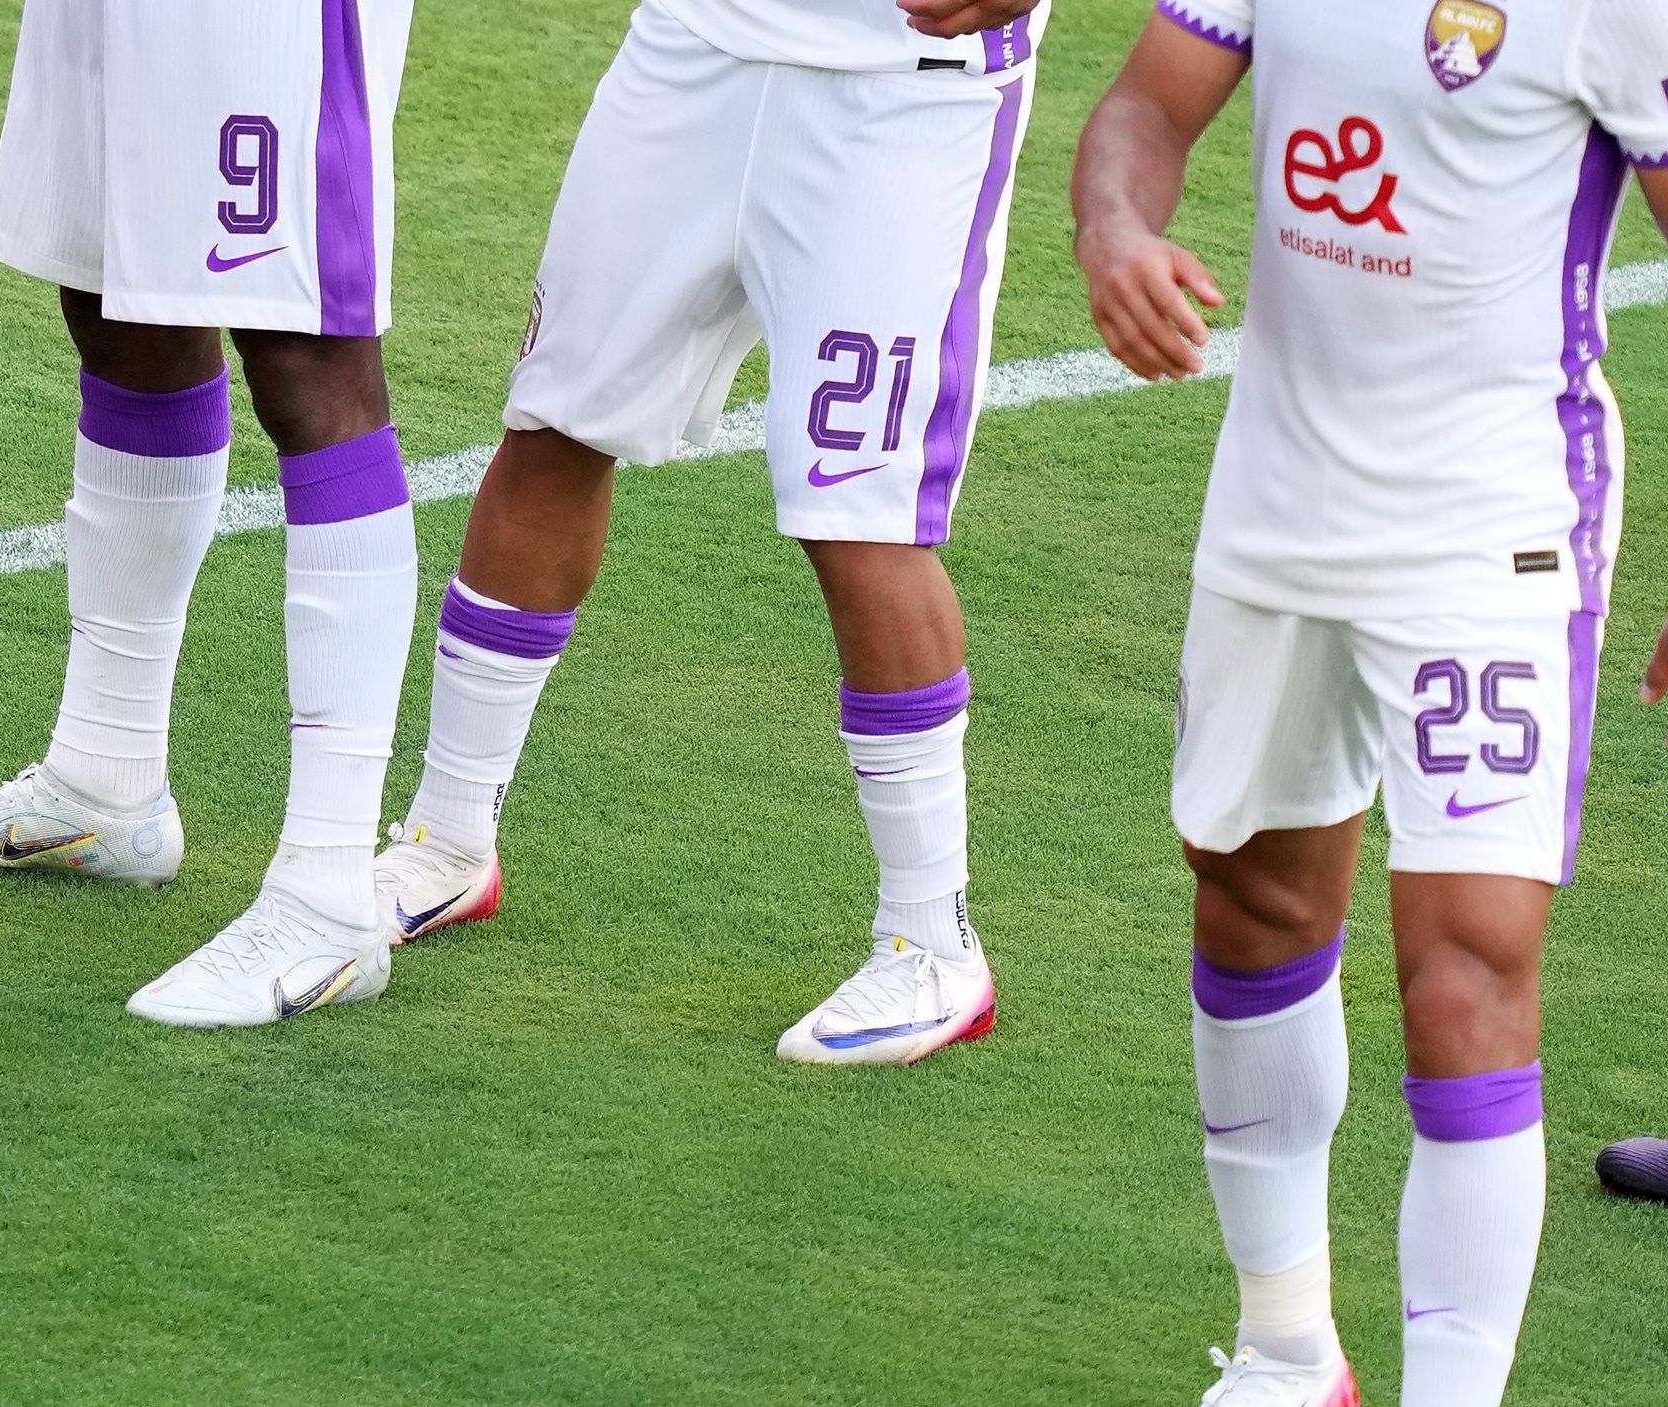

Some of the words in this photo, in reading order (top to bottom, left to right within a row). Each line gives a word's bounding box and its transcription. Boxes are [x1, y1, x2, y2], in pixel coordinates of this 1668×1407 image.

[217, 115, 279, 234] 9
[1280, 227, 1355, 268] etisalat
[1362, 253, 1412, 277] and
[807, 329, 916, 451] 21
[1414, 658, 1540, 775] 25
